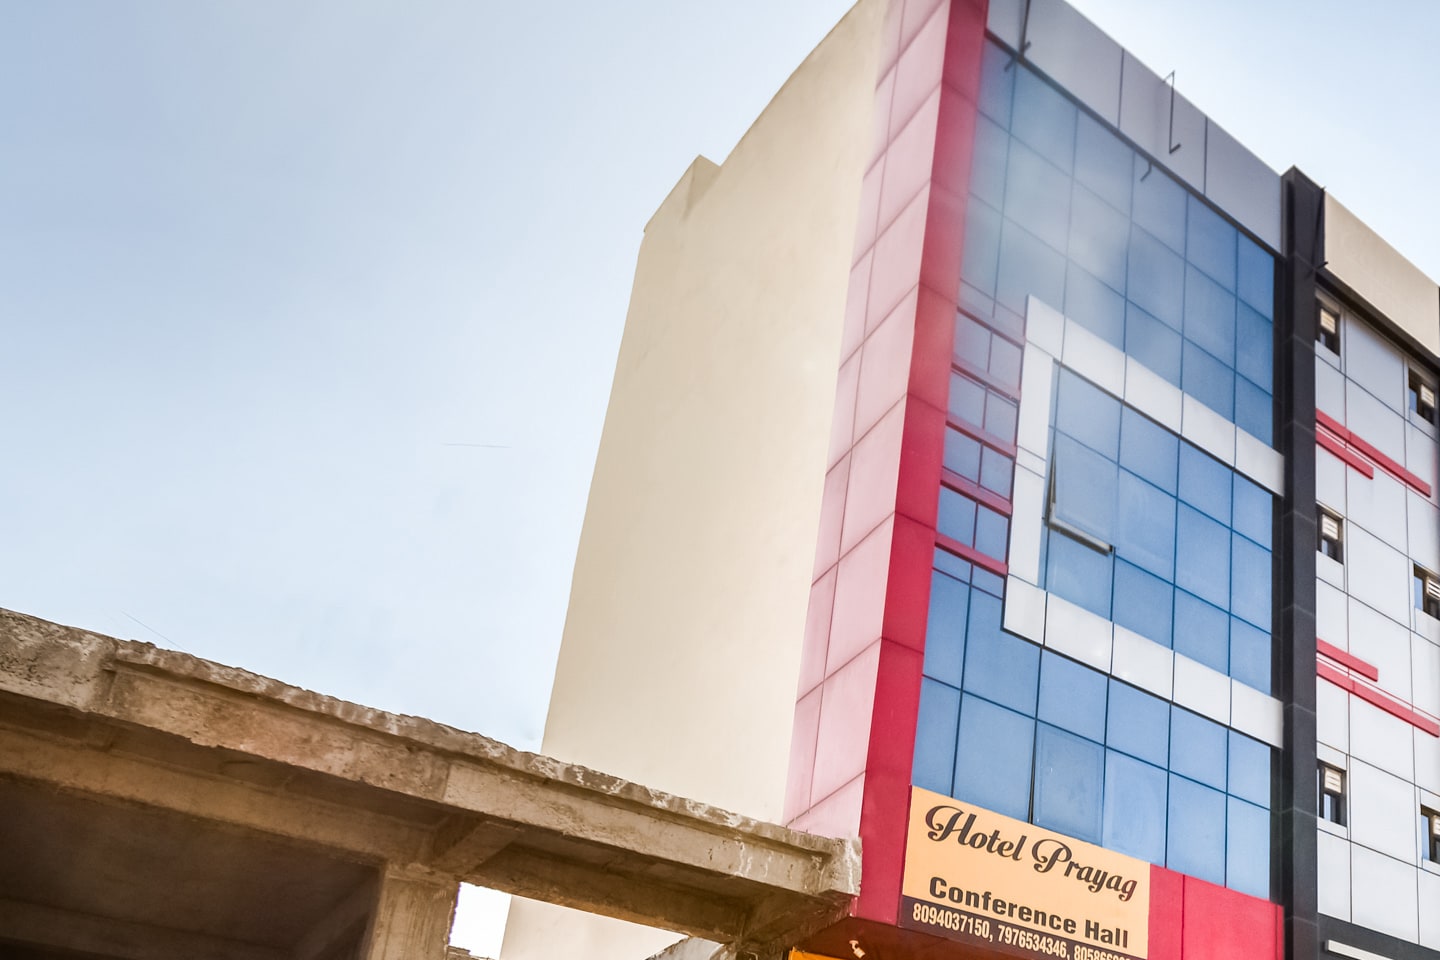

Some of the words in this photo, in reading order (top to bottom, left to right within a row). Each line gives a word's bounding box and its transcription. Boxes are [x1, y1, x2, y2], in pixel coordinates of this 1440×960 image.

[925, 805, 1028, 861] Hotel
[1031, 838, 1138, 902] Prayag
[912, 902, 993, 943] 8094037150,
[929, 876, 1077, 935] Conference
[1085, 919, 1129, 949] Hall
